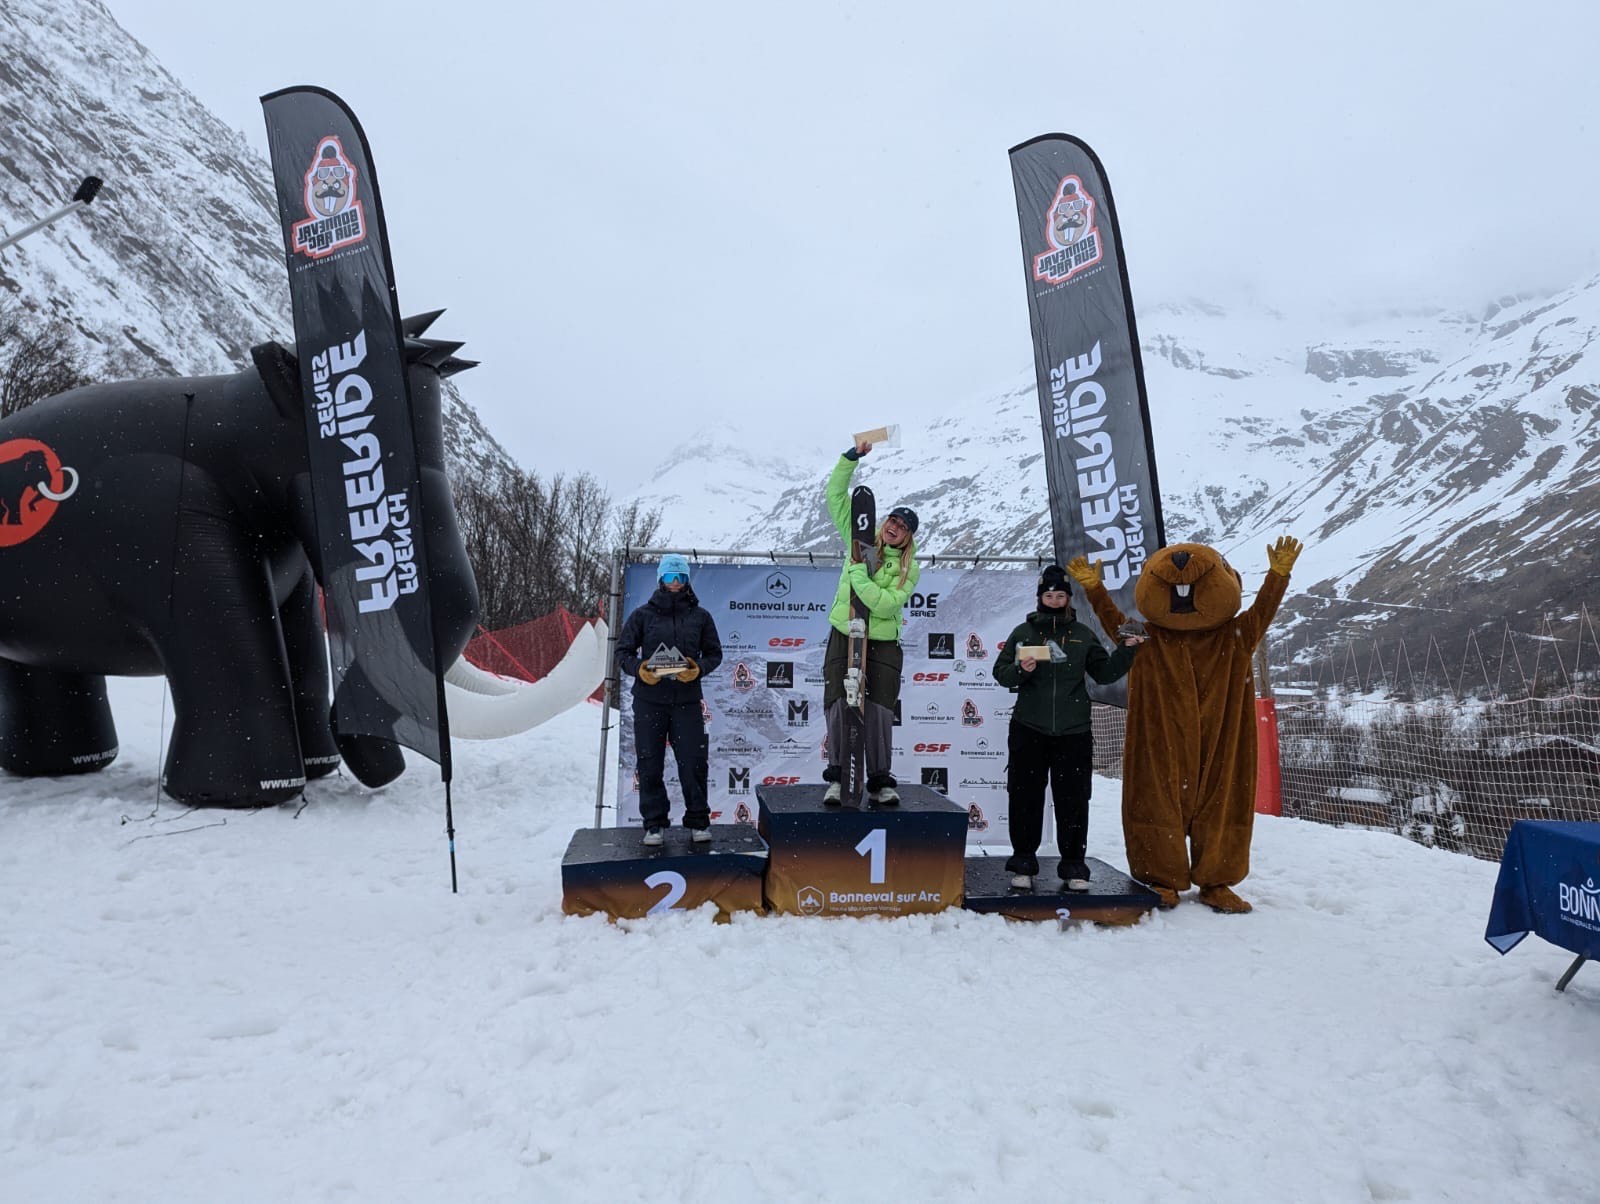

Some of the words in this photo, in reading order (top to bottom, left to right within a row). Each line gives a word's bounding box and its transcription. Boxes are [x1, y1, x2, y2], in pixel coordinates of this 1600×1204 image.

[729, 600, 785, 611] Bonneval
[787, 603, 805, 612] sur
[807, 602, 827, 612] Arc
[910, 610, 937, 618] SERIES
[855, 828, 887, 884] 1
[644, 870, 687, 917] 2
[829, 891, 894, 904] Bonneval
[896, 892, 916, 903] sur
[918, 890, 941, 903] Arc
